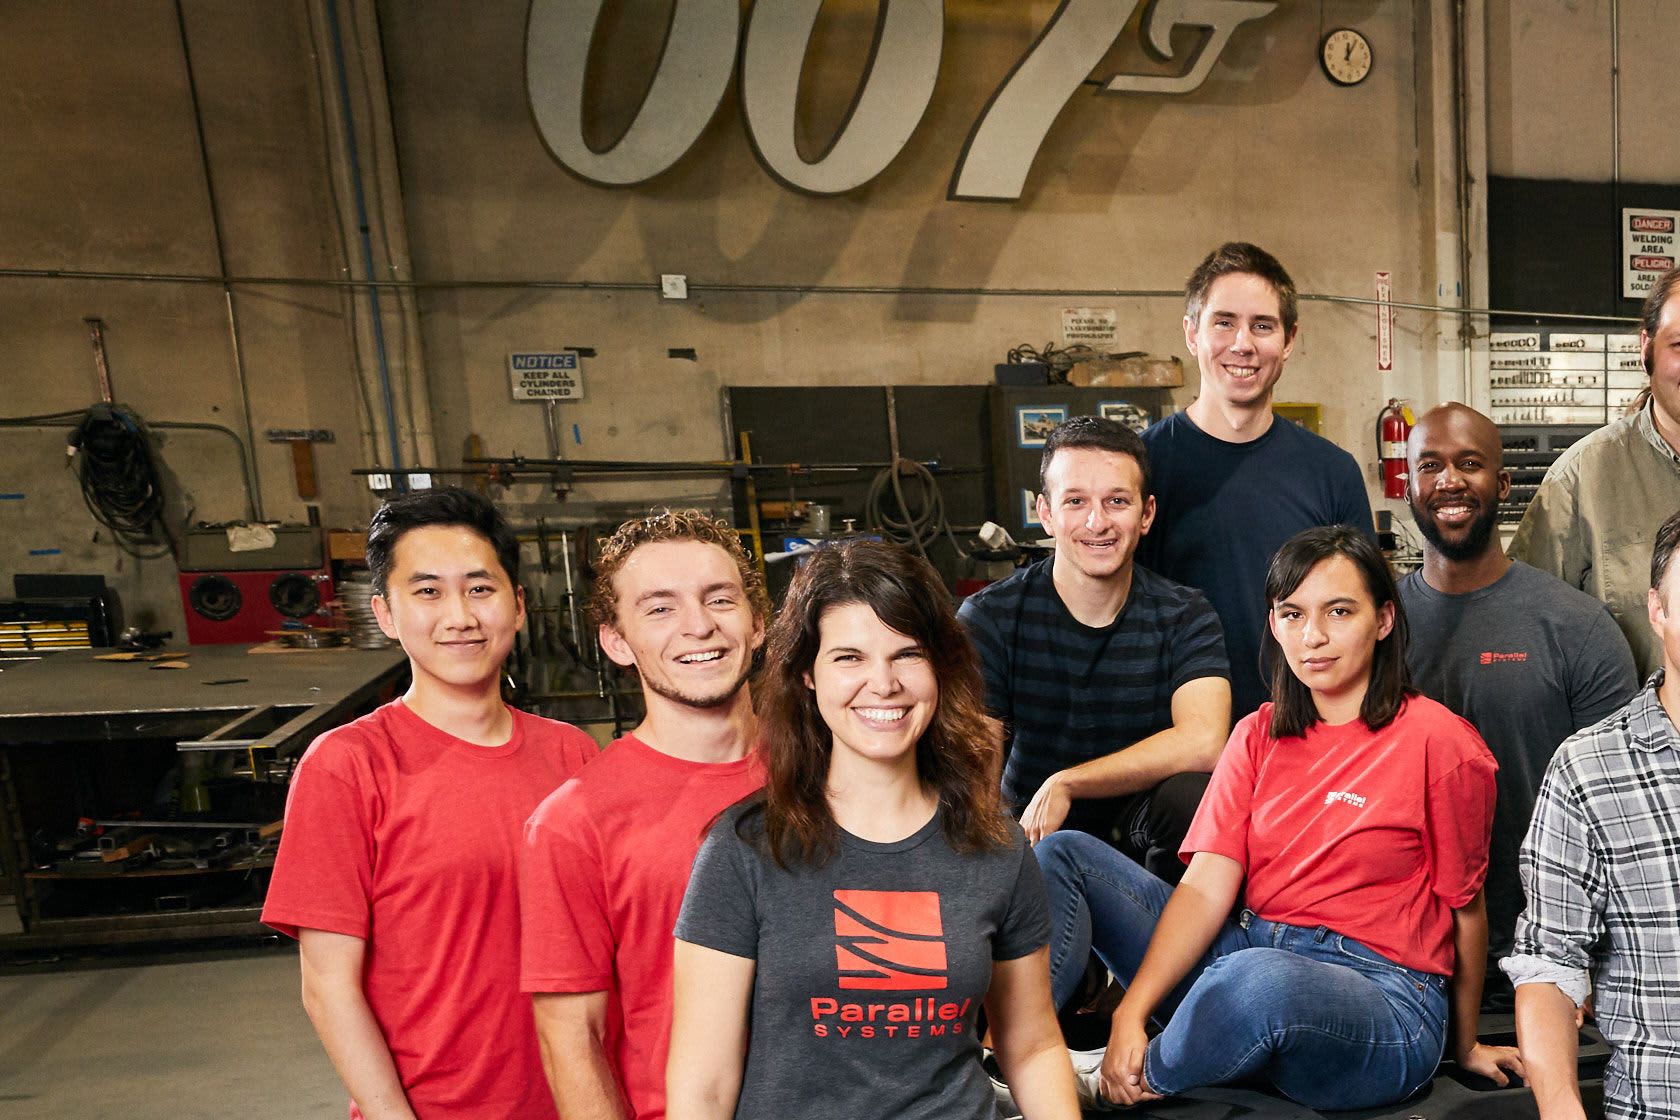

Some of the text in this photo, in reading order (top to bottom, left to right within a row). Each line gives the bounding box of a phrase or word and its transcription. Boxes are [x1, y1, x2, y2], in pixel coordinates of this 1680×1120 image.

[1633, 219, 1671, 230] DANGER
[1632, 234, 1673, 244] WELDING
[1640, 245, 1664, 254] AREA
[1633, 260, 1671, 269] PELIGRO
[1637, 274, 1656, 282] AREA
[515, 356, 573, 368] NOTICE
[552, 371, 570, 379] ALL
[520, 380, 576, 388] CYLINDERS
[527, 388, 571, 396] CHAINED
[810, 997, 972, 1022] Parallel
[814, 1022, 964, 1039] SYSTEMS
